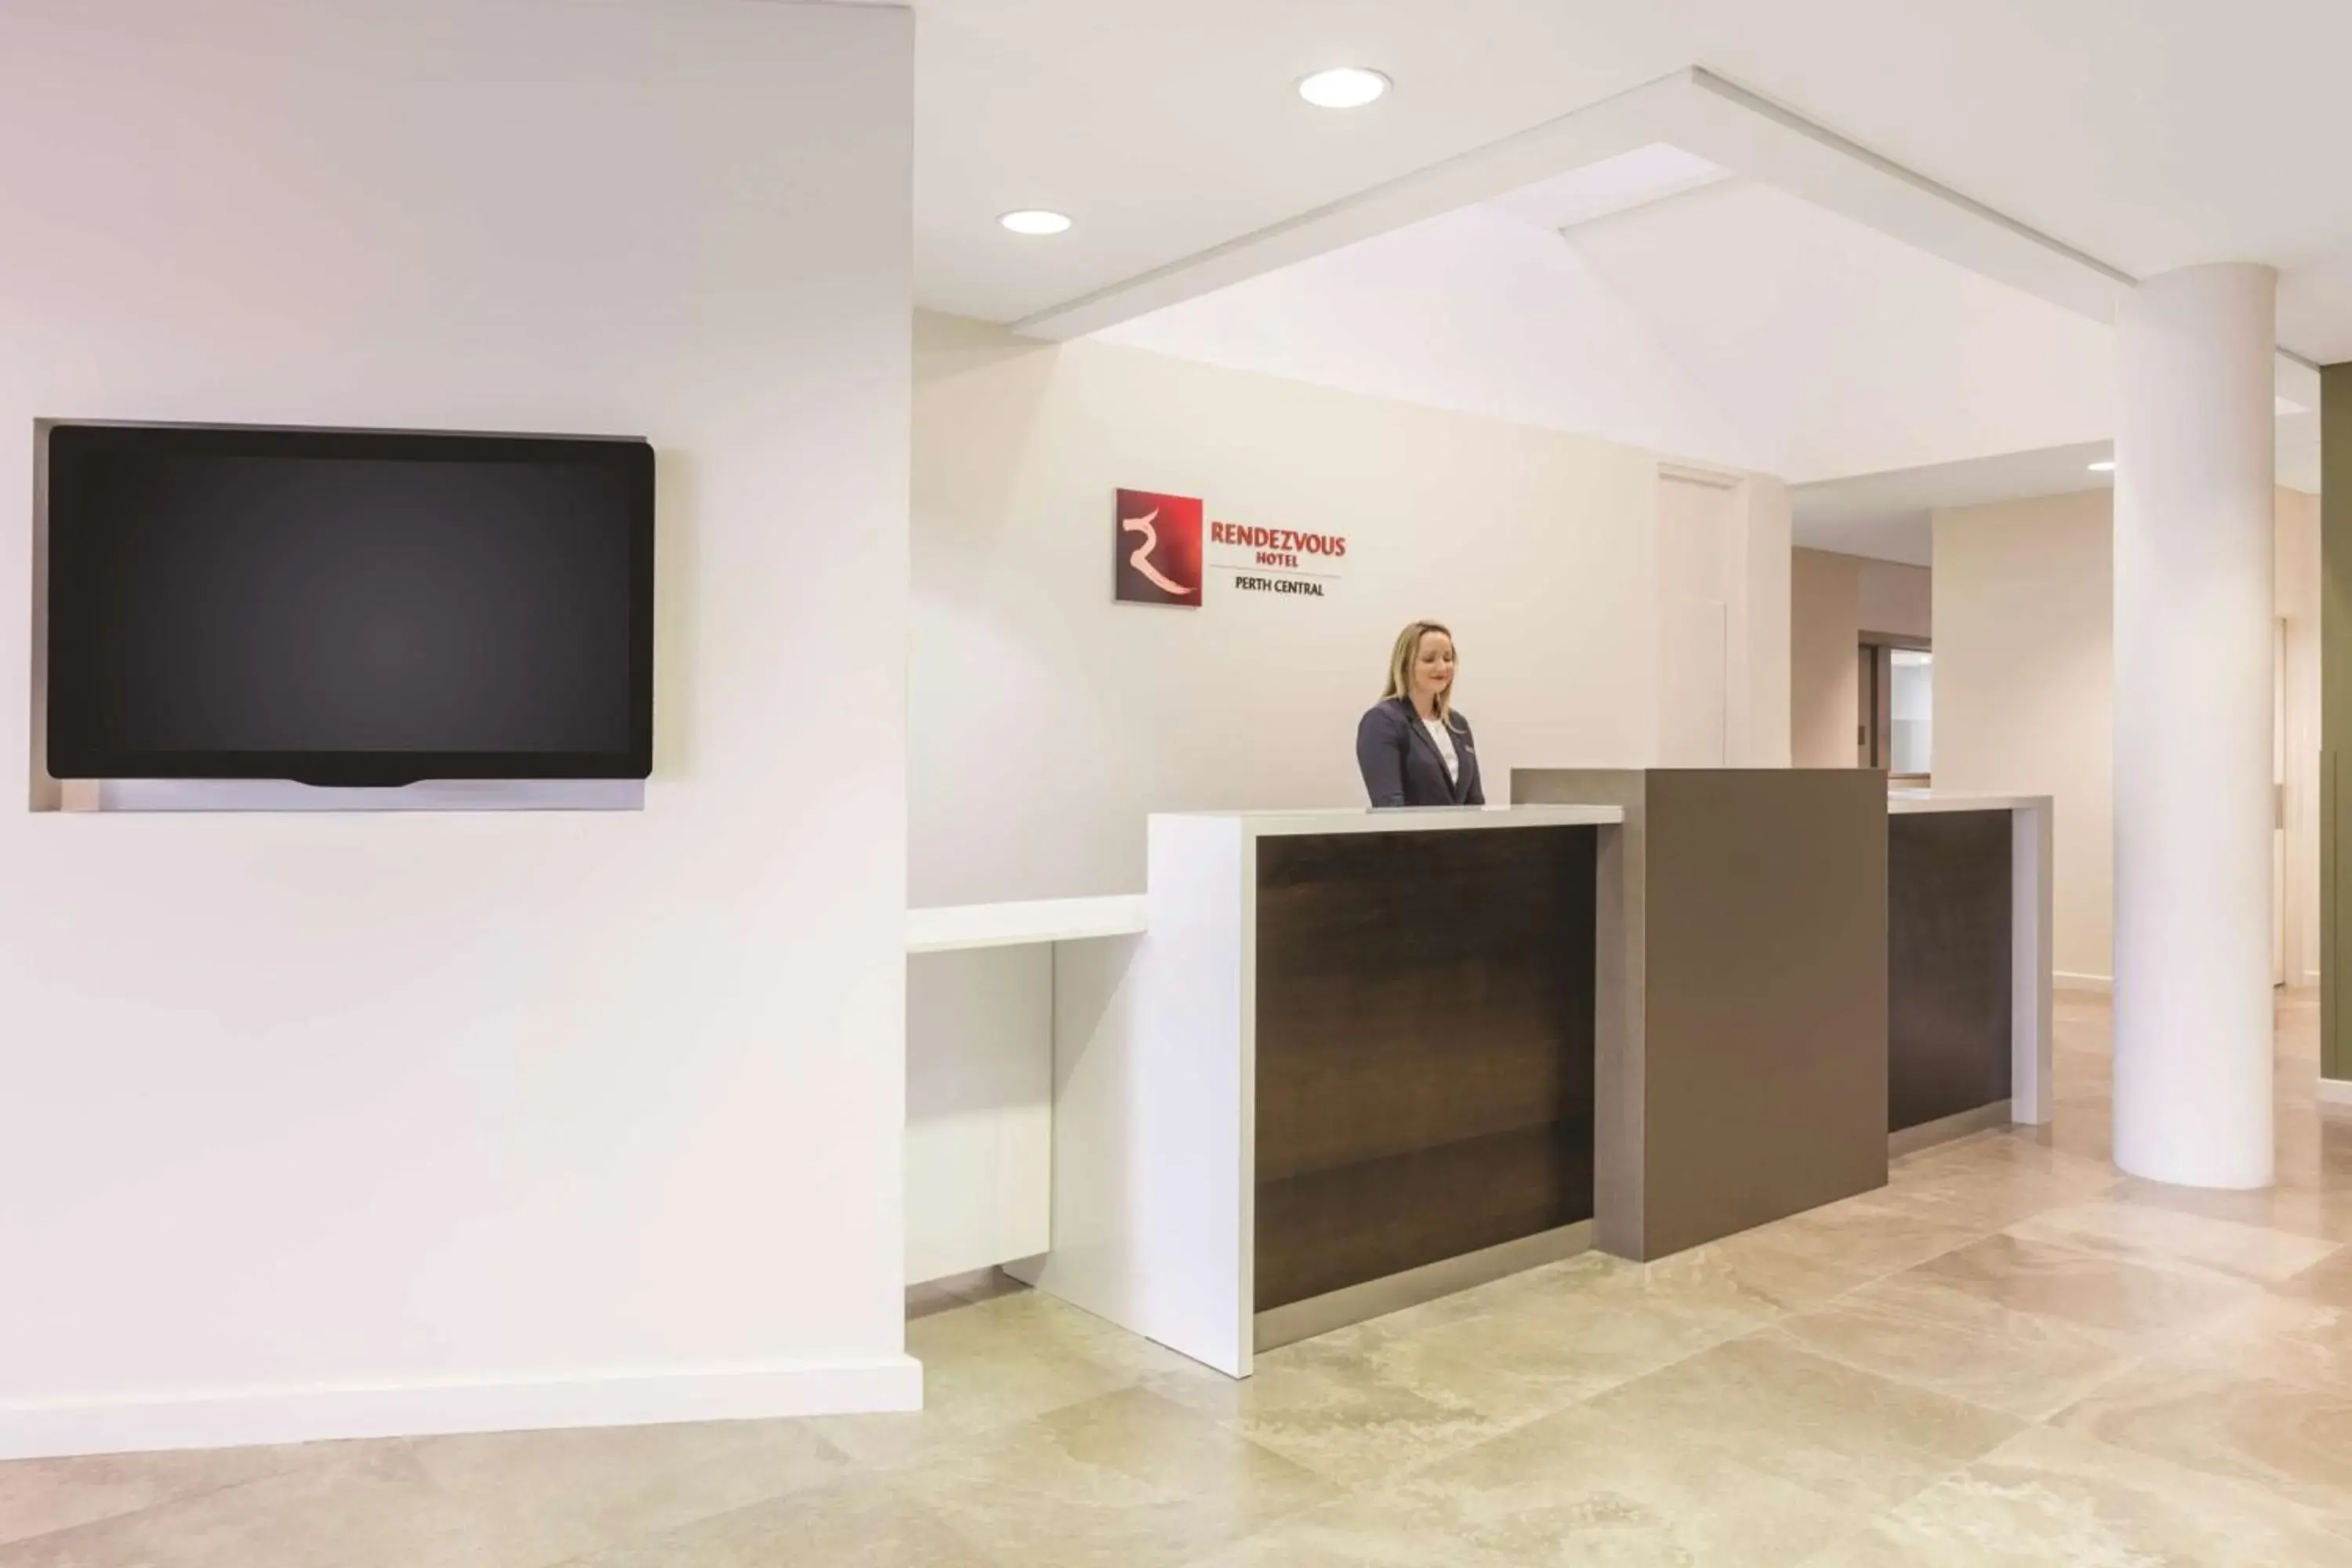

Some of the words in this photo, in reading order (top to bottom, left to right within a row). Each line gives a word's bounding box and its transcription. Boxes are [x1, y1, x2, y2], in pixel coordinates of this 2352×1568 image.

[1210, 521, 1347, 557] RENDEZVOUS
[1256, 551, 1298, 568] HOTEL
[1236, 576, 1272, 593] PERTH
[1274, 579, 1324, 597] CENTRAL
